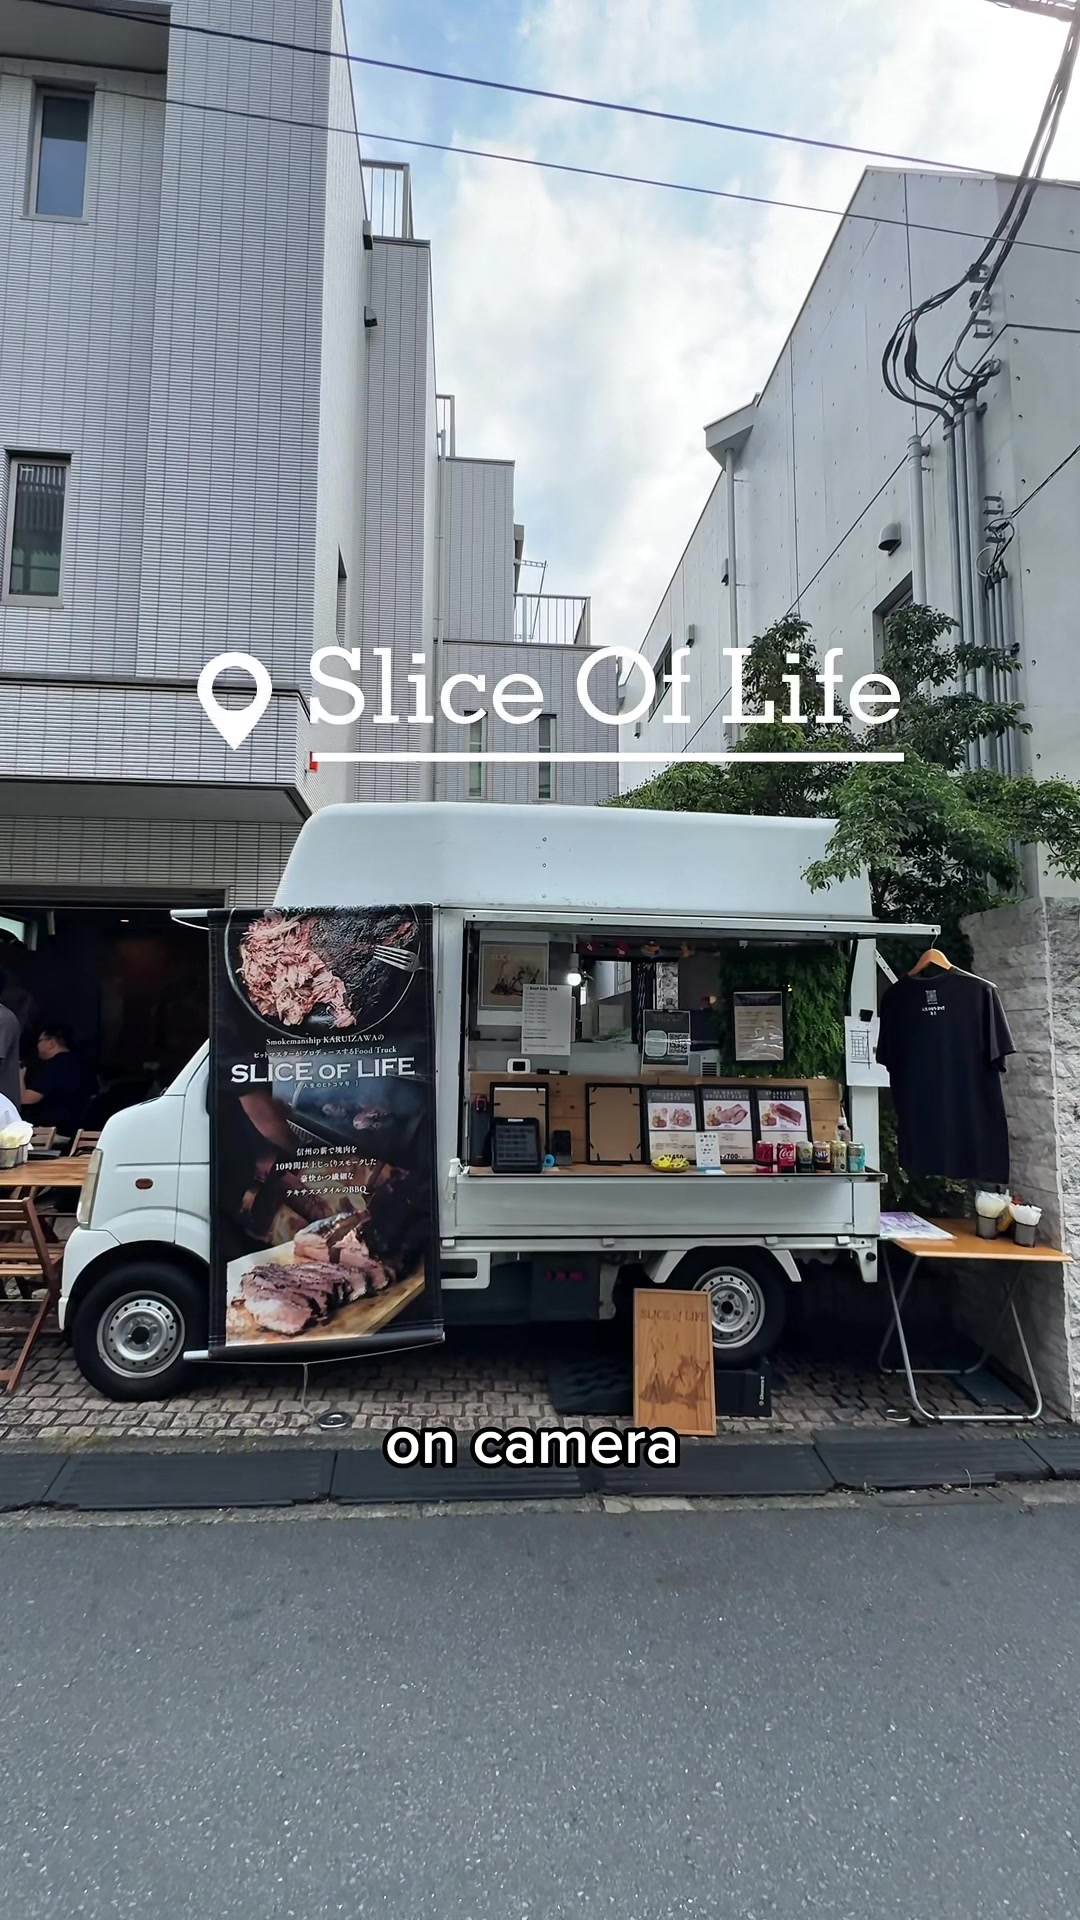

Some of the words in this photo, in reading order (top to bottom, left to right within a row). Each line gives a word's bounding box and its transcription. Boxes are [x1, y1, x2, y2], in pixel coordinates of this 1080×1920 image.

[266, 1037, 322, 1047] Smokemanship
[323, 1034, 385, 1044] KARUIZAWAの
[374, 1045, 397, 1055] Truck
[230, 1062, 313, 1084] SLICE
[318, 1063, 351, 1080] OF
[357, 1056, 415, 1078] LIFE
[275, 1158, 377, 1171] 10時間以上じっくりスモークした
[300, 1172, 354, 1183] 豪快かつ繊細な
[286, 1185, 370, 1198] テキサススタイルのBBQ
[640, 1308, 671, 1320] SLICE
[684, 1310, 707, 1322] LIFE
